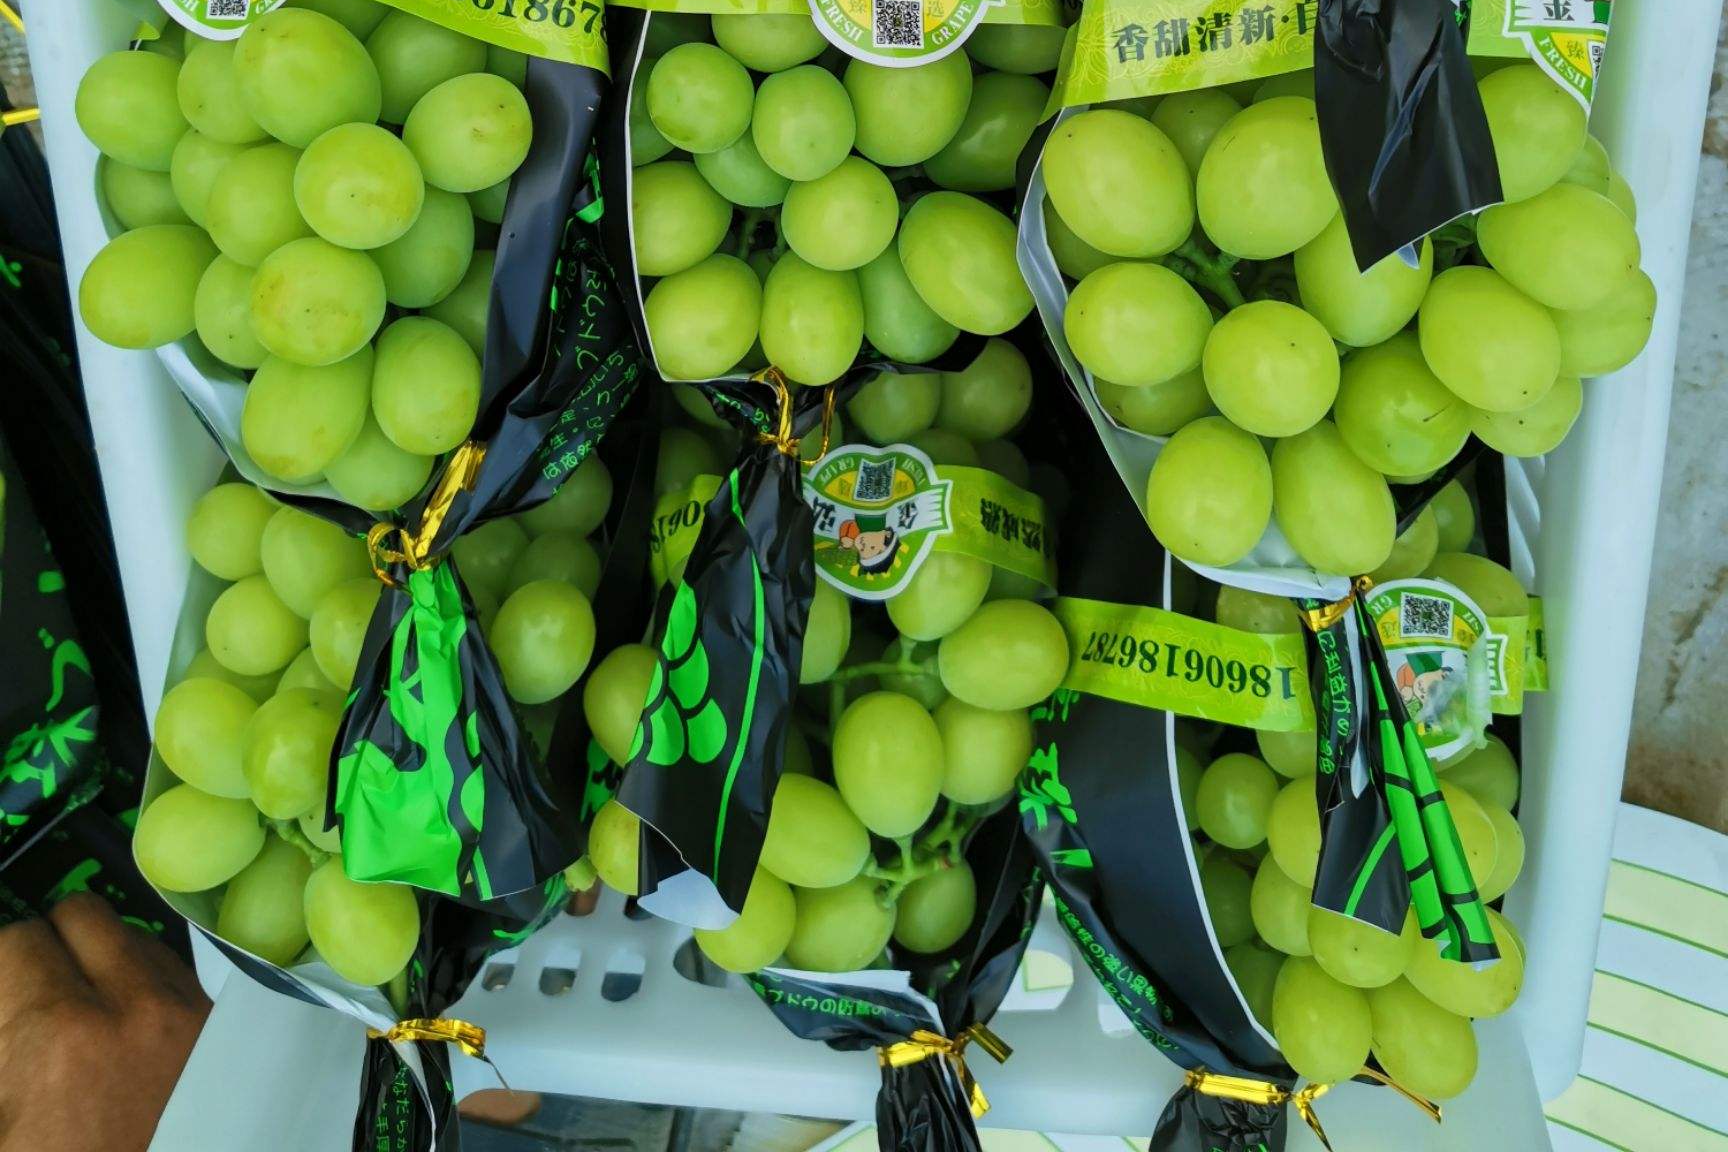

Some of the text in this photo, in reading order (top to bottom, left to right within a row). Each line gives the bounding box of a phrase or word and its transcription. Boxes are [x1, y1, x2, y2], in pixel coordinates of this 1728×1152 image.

[930, 2, 975, 46] GRAPE
[1538, 35, 1589, 90] FRESH
[1081, 631, 1297, 700] 18606186787
